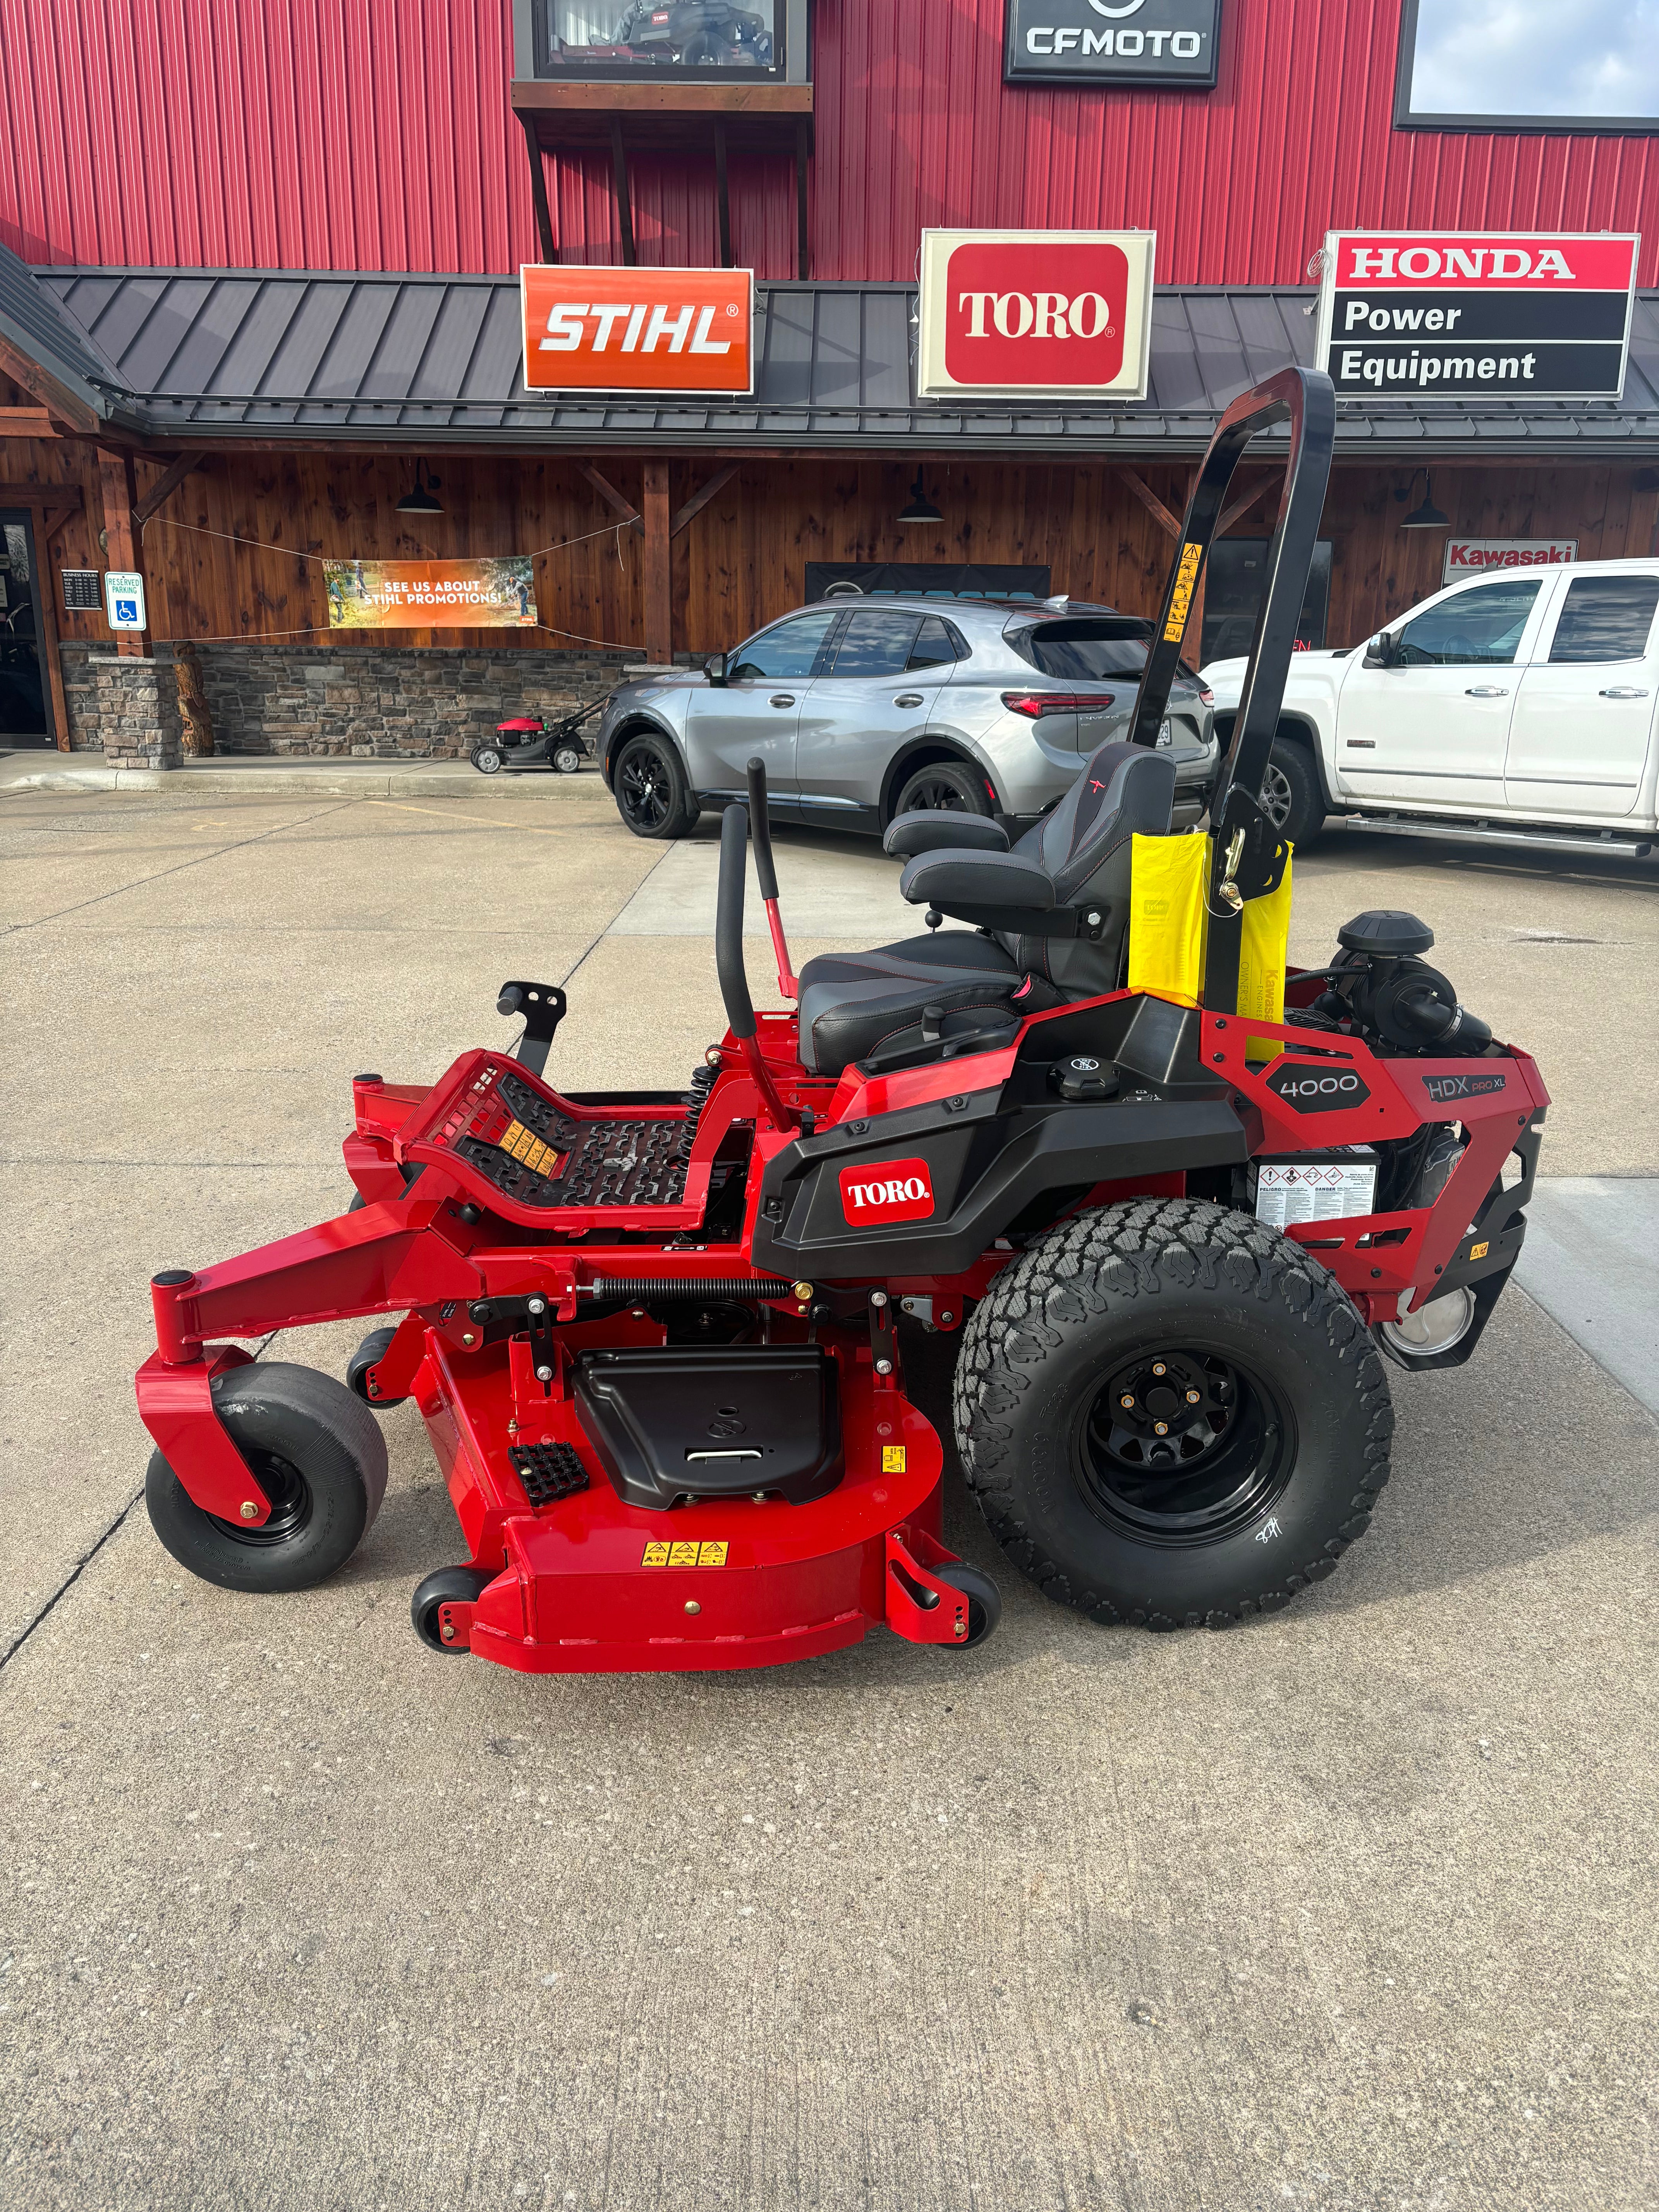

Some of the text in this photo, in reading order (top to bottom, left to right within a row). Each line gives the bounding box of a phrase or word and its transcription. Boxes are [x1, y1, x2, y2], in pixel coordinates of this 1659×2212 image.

[1026, 27, 1201, 58] CFMOTO
[1349, 247, 1576, 279] HONDA
[539, 303, 731, 354] STIHL
[959, 291, 1110, 339] TORO
[1344, 301, 1462, 331] Power
[1341, 349, 1536, 386] Equipment
[1450, 545, 1571, 566] Kawasaki
[364, 592, 502, 605] STIHL PROMOTIONS!
[385, 581, 480, 592] SEE US ABOUT
[1293, 640, 1311, 652] EN
[1239, 962, 1249, 1001] OWNER'S
[1264, 970, 1278, 1022] Kawasa
[1280, 1075, 1358, 1097] 4000
[1429, 1077, 1505, 1100] HDX PRO XL
[848, 1178, 925, 1207] TORO
